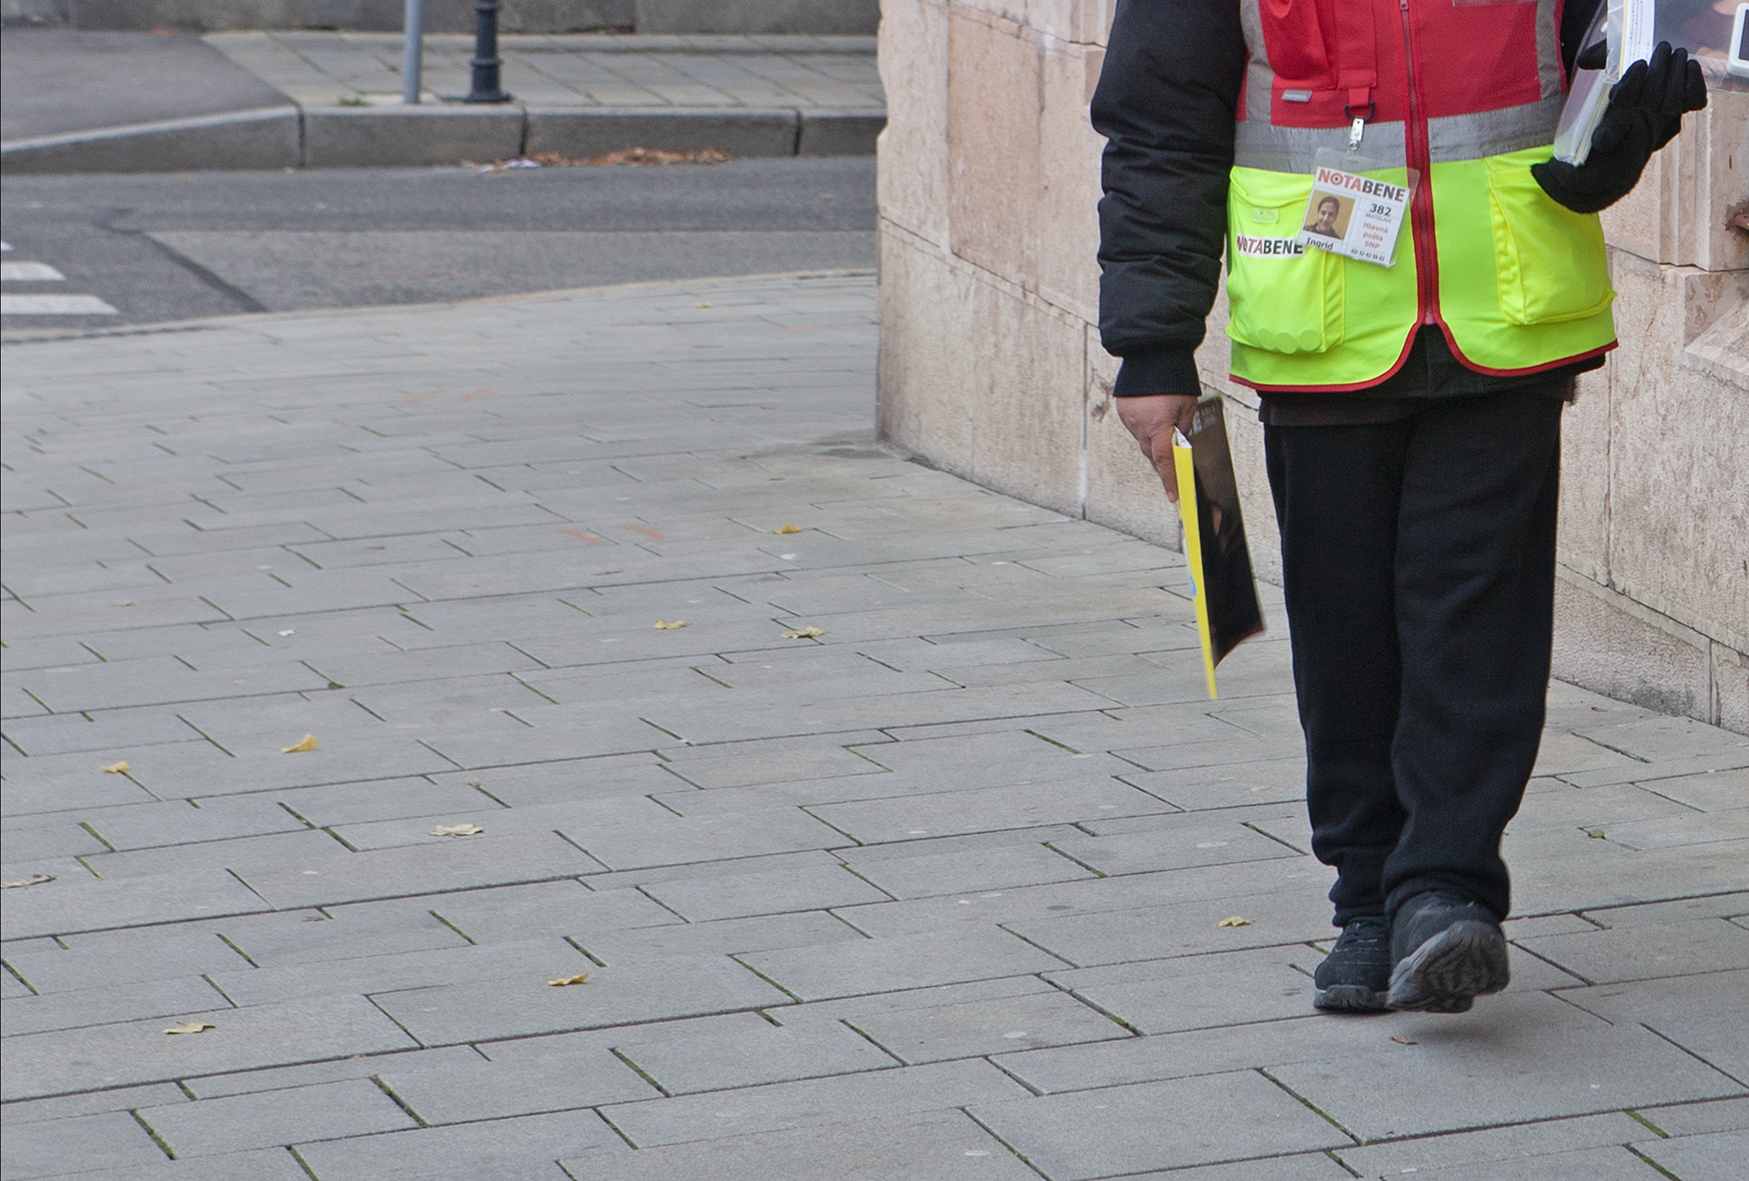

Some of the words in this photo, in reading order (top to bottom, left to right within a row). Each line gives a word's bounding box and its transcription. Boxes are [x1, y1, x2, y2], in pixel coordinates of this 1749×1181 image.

[1318, 169, 1406, 203] NOTABENE
[1370, 203, 1392, 217] 382
[1363, 222, 1388, 234] Hlavná
[1306, 237, 1334, 250] Ingrid
[1362, 232, 1383, 242] pošta
